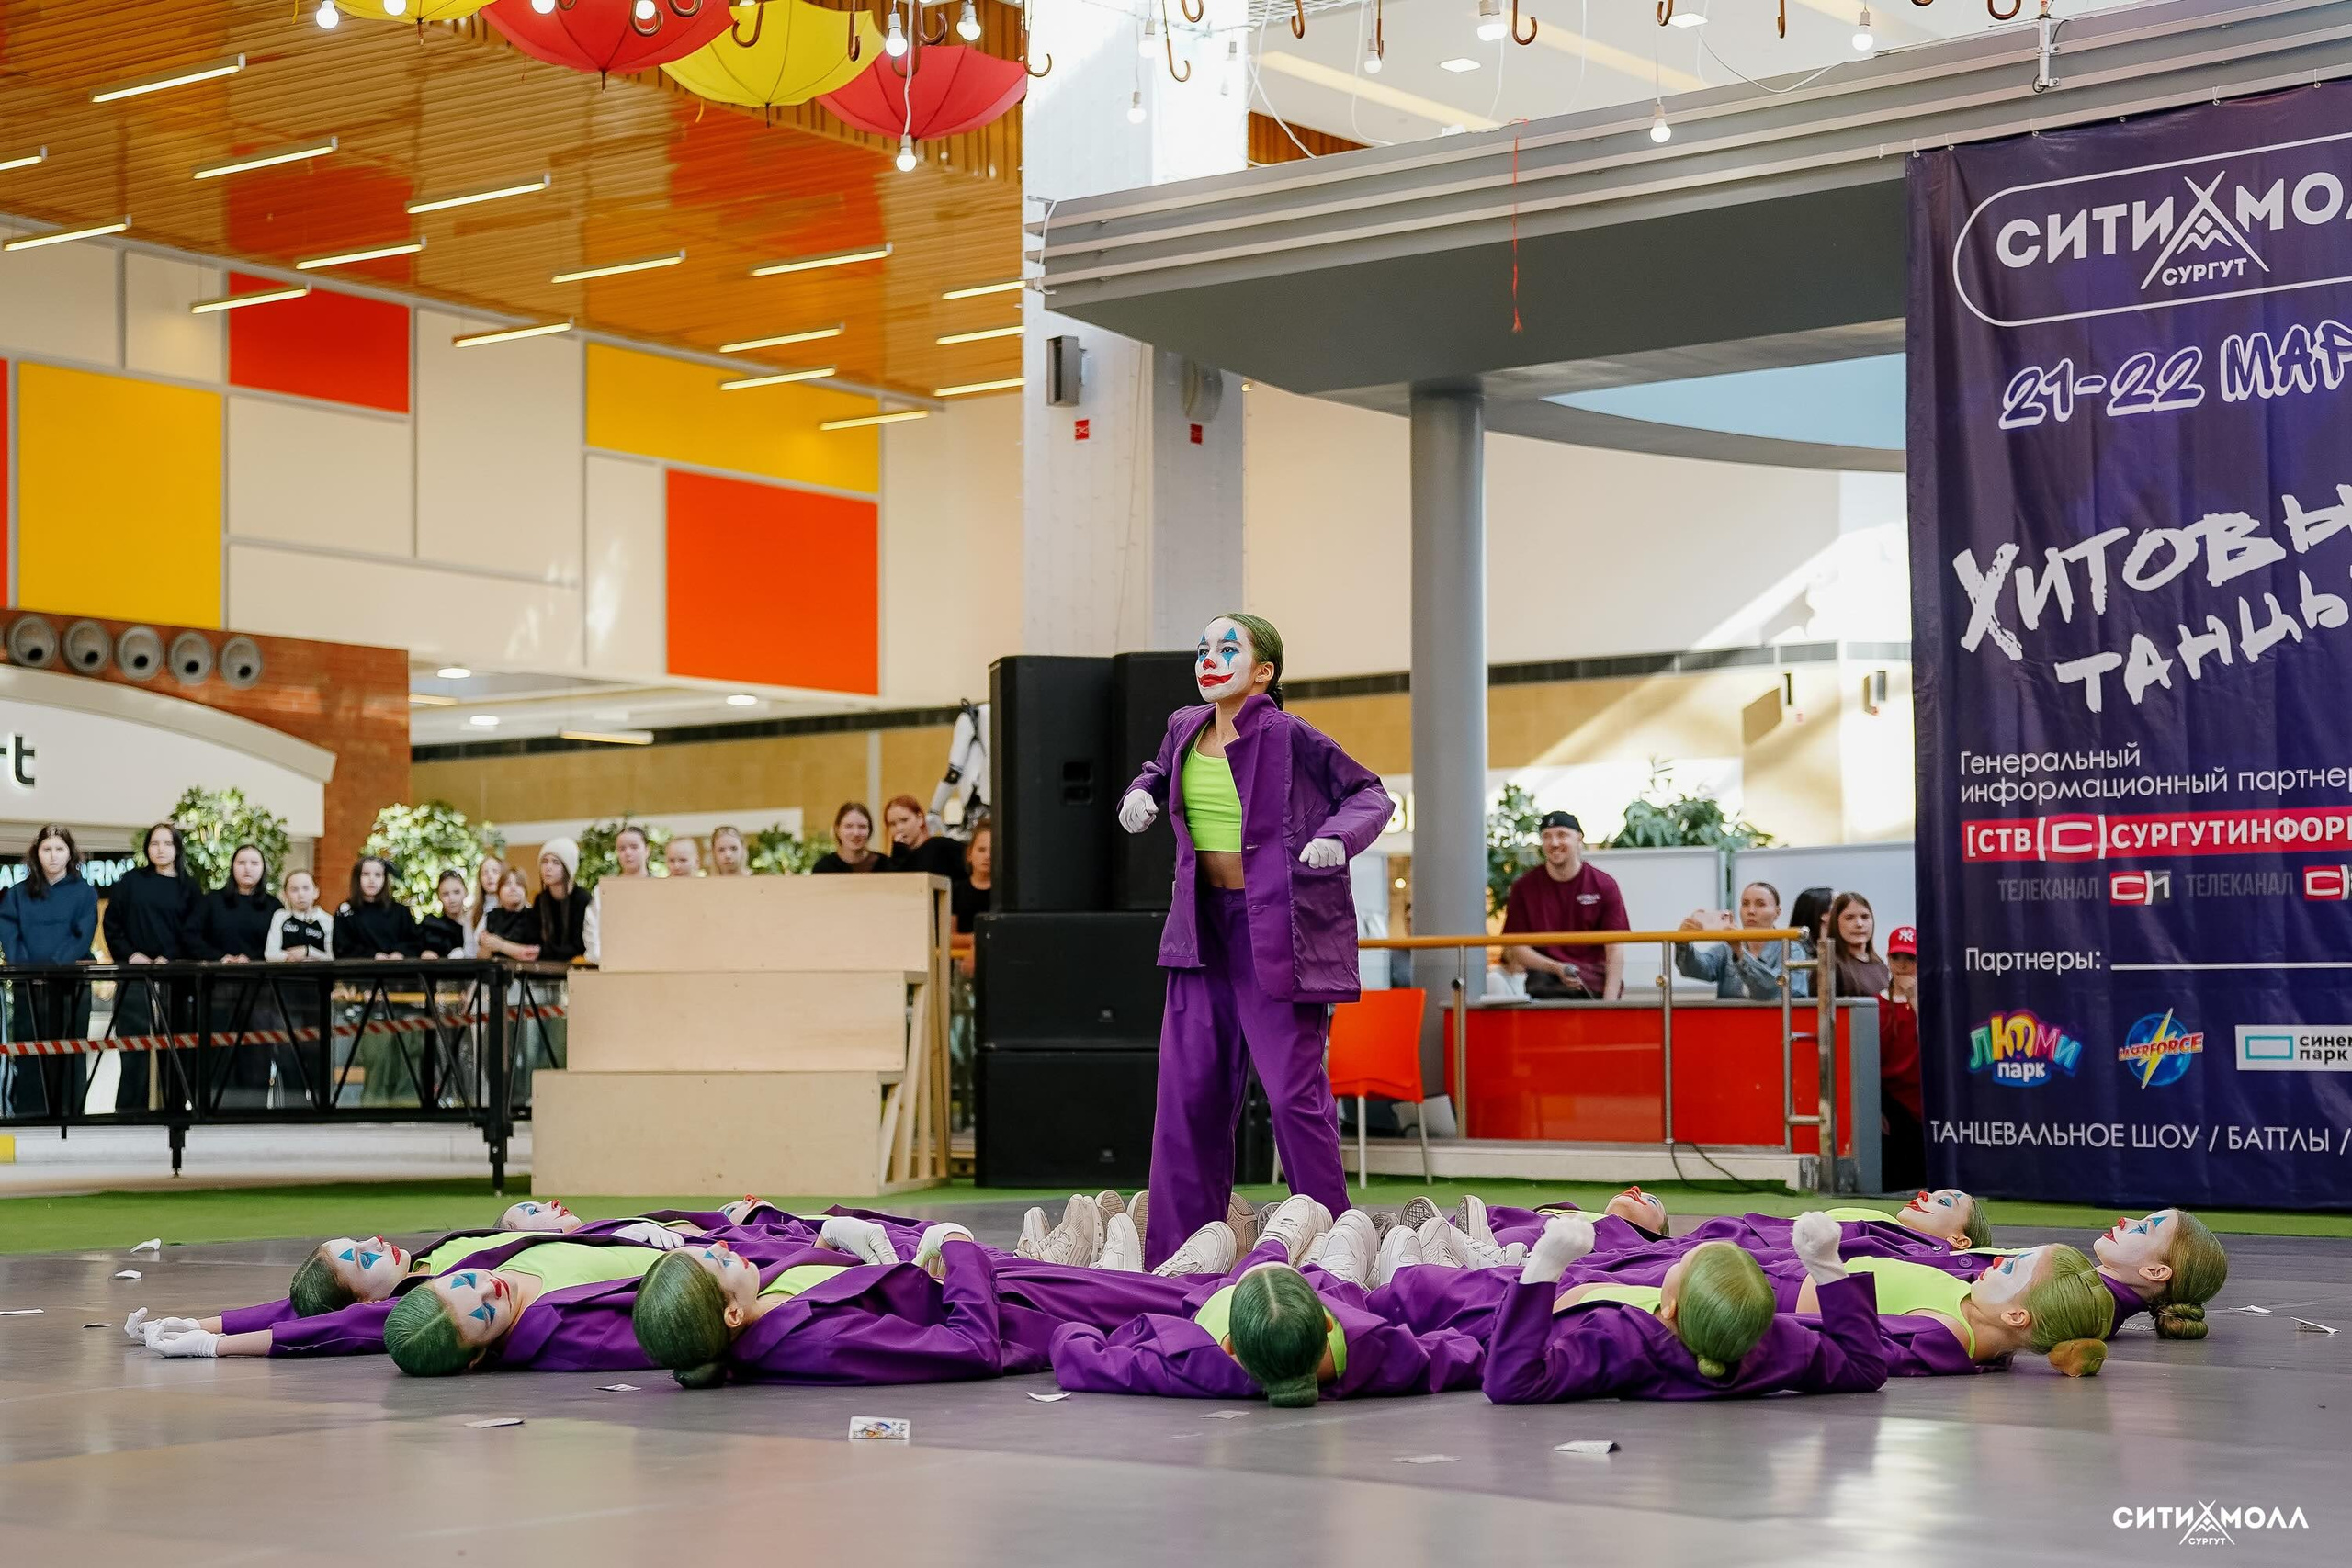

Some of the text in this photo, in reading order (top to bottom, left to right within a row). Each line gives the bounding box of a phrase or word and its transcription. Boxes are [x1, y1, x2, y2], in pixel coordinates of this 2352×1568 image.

[1996, 172, 2352, 268] СИТИ МО
[2161, 257, 2247, 286] СУРГУТ
[1998, 345, 2205, 430] 21-22
[1960, 741, 2141, 777] Генеральный
[1960, 766, 2352, 807] информационный партне
[1997, 877, 2099, 903] ТЕЛЕКАНАЛ
[2185, 871, 2294, 897] ТЕЛЕКАНАЛ
[1965, 947, 2101, 976] Партнеры:
[1996, 1061, 2047, 1083] парк
[2299, 1048, 2349, 1065] парк
[1930, 1120, 2125, 1148] ТАНЦЕВАЛЬНОЕ
[2132, 1125, 2199, 1149] ШОУ
[2228, 1125, 2330, 1152] БАТТЛЫ
